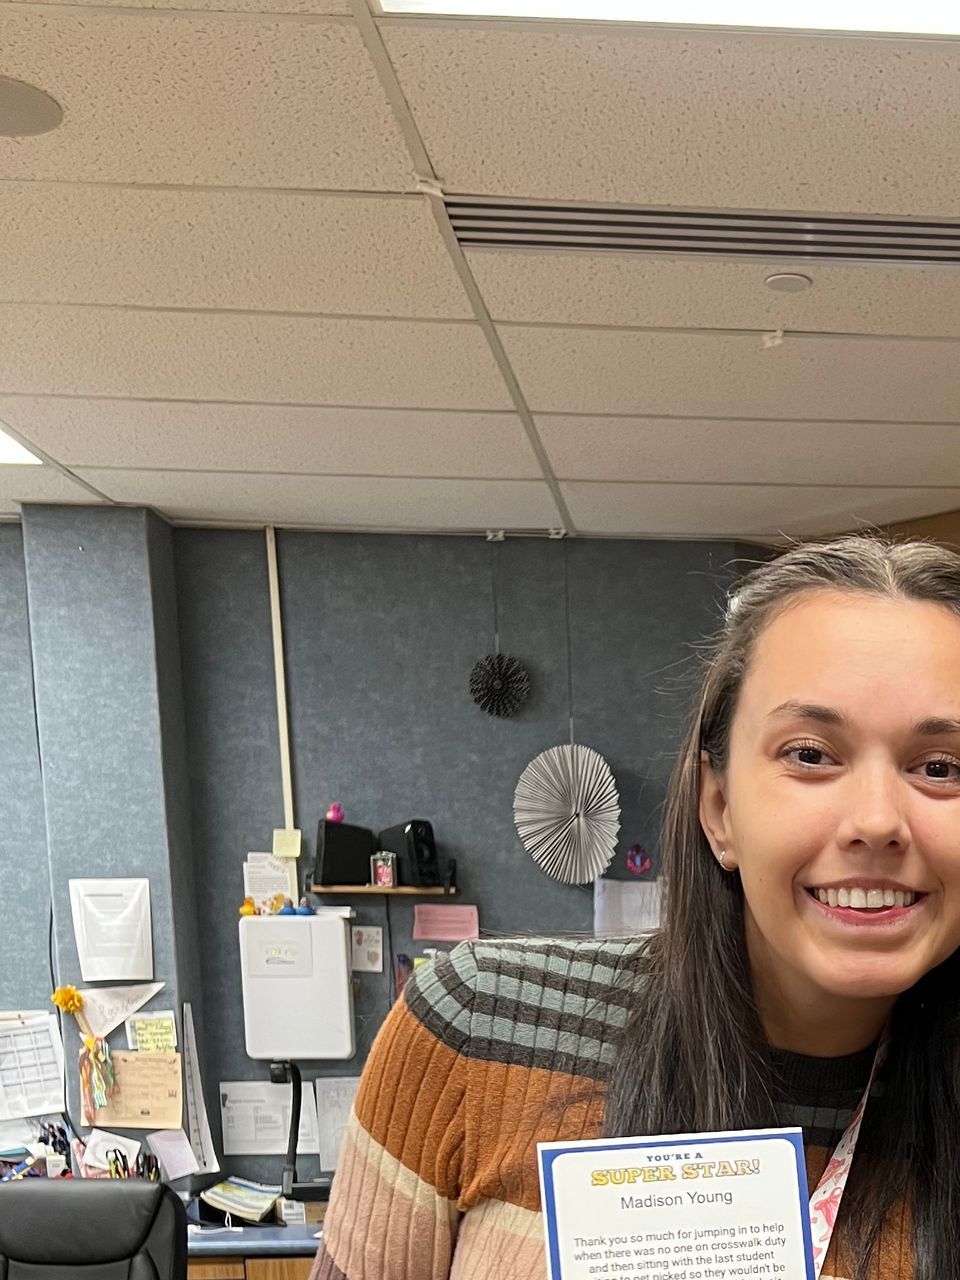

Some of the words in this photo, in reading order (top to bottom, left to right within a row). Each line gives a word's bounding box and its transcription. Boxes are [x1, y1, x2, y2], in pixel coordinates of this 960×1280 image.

[646, 1153, 690, 1162] YOU'RE
[591, 1164, 677, 1187] SUPER
[682, 1159, 761, 1179] STAR!
[621, 1194, 683, 1210] Madison
[686, 1190, 733, 1207] Young
[573, 1236, 607, 1247] Thank
[608, 1236, 628, 1247] you
[630, 1235, 643, 1243] so
[646, 1231, 675, 1242] much
[677, 1229, 692, 1239] for
[694, 1227, 736, 1240] jumping
[738, 1225, 747, 1234] in
[750, 1225, 760, 1234] to
[763, 1223, 785, 1235] help
[574, 1250, 602, 1261] when
[604, 1249, 631, 1259] there
[633, 1247, 655, 1256] was
[657, 1246, 671, 1254] no
[674, 1244, 693, 1253] one
[695, 1244, 709, 1252] on
[711, 1237, 762, 1250] crosswalk
[764, 1236, 787, 1247] duty
[588, 1264, 608, 1274] and
[611, 1262, 634, 1272] then
[636, 1259, 669, 1270] sitting
[671, 1256, 694, 1267] with
[696, 1256, 712, 1265] the
[715, 1253, 734, 1264] last
[736, 1250, 775, 1262] student
[689, 1271, 702, 1279] so
[704, 1268, 726, 1279] they
[728, 1263, 770, 1275] wouldn't
[773, 1263, 786, 1272] be
